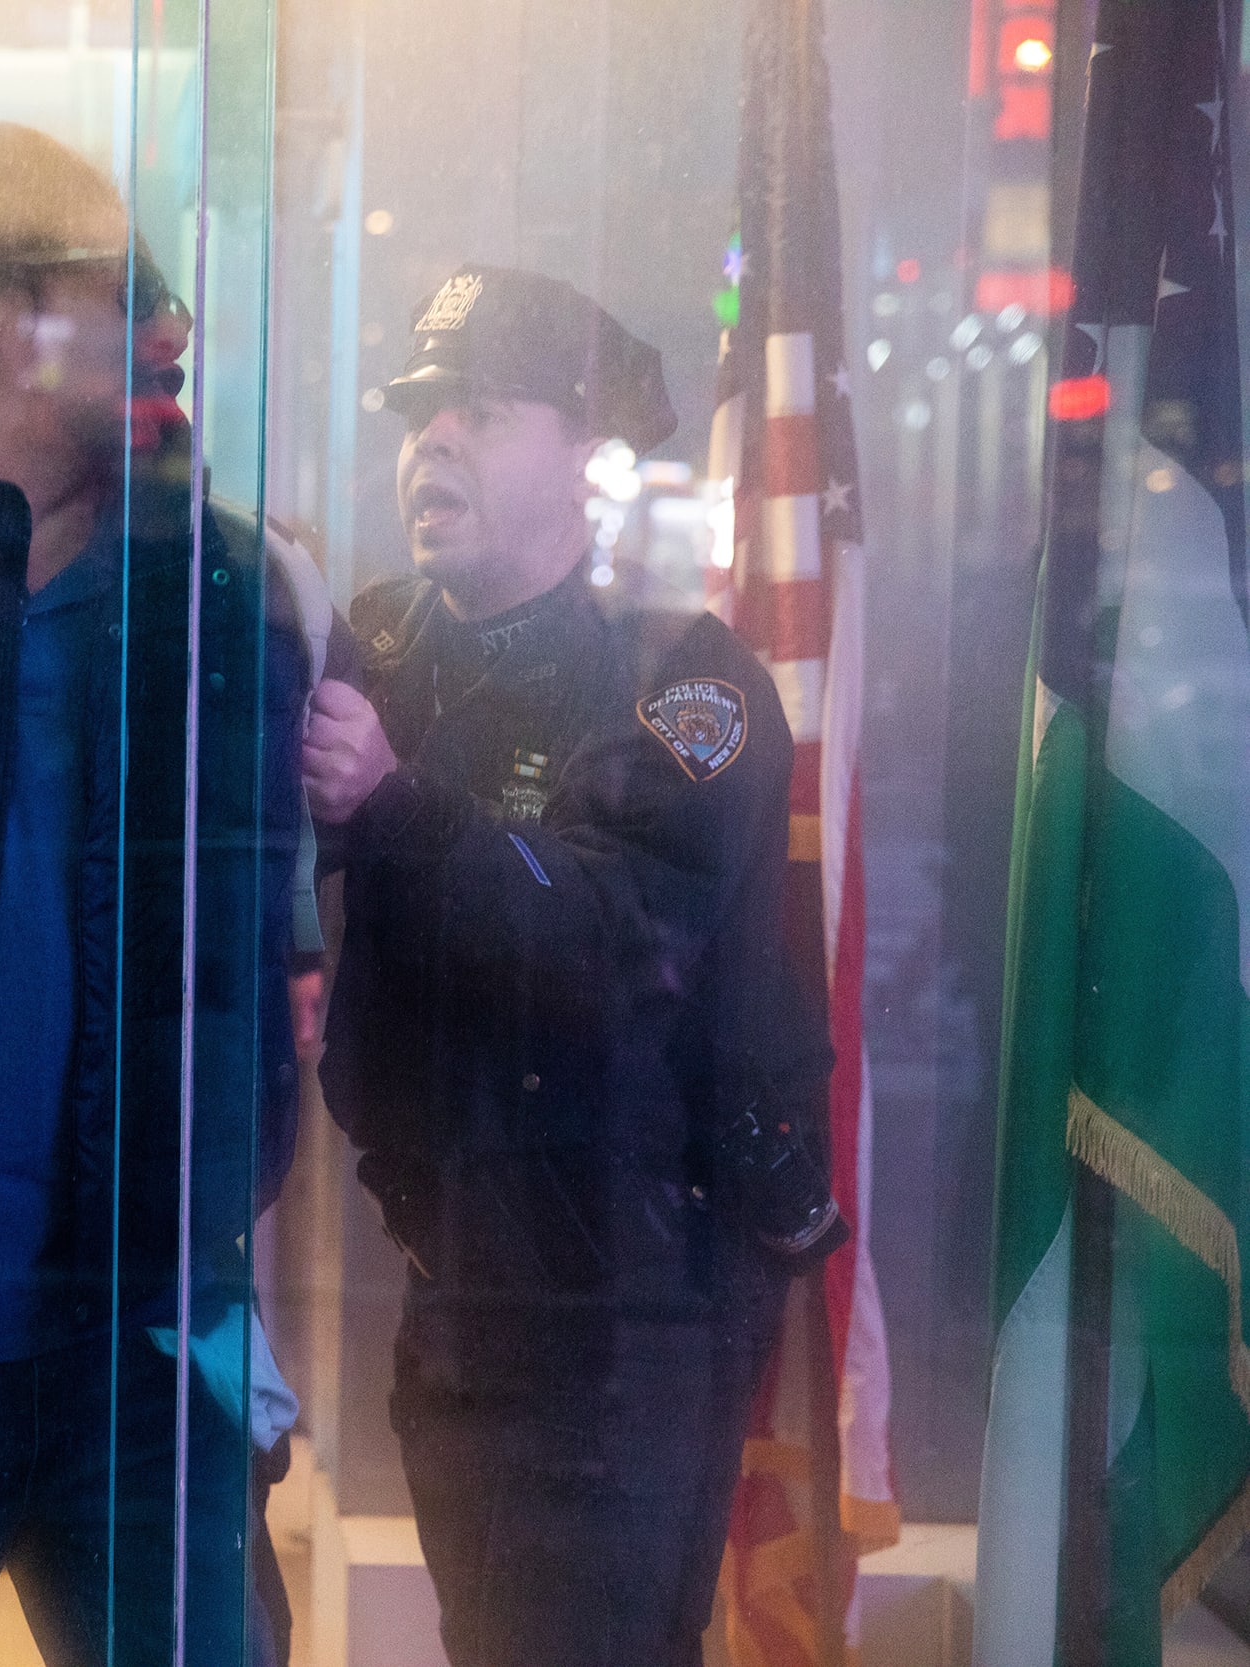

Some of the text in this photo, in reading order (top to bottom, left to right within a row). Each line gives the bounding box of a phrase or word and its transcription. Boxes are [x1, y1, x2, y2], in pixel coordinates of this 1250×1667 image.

[665, 682, 718, 697] POLICE
[651, 717, 690, 758] CITY OF
[708, 746, 731, 770] NEW
